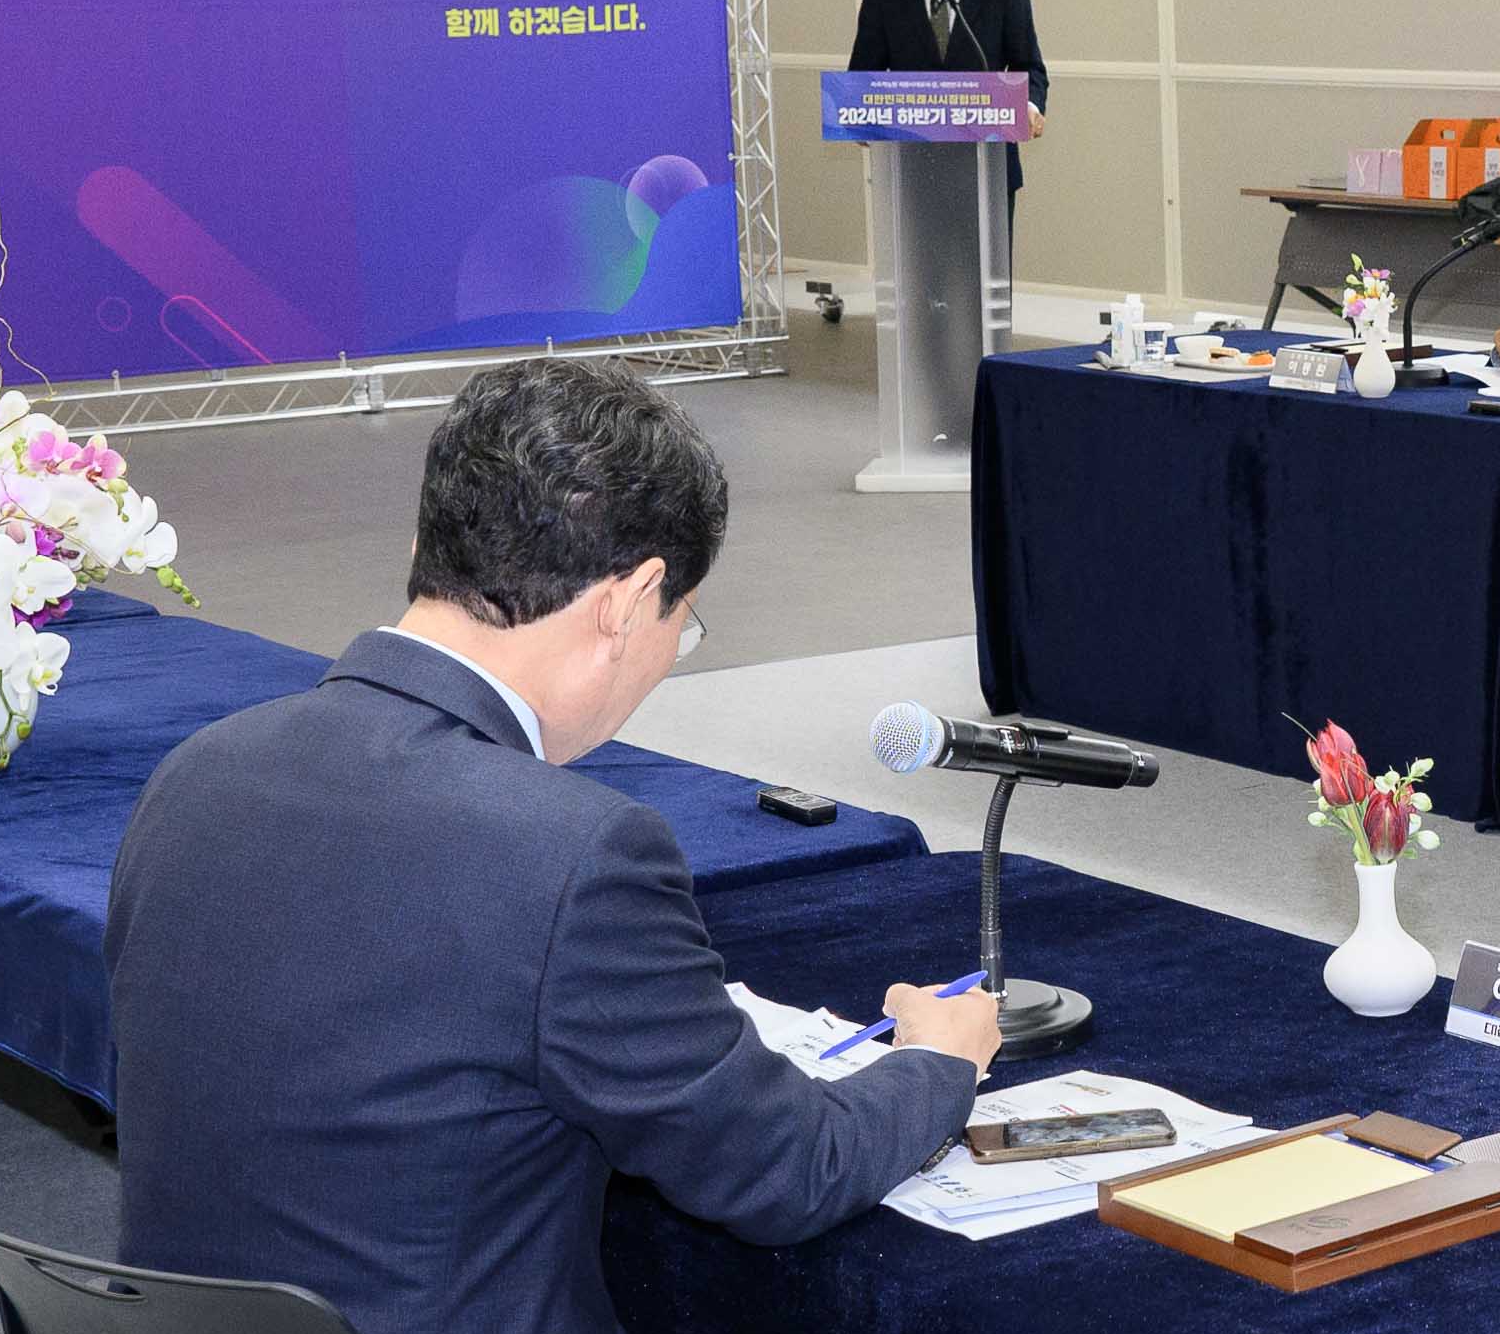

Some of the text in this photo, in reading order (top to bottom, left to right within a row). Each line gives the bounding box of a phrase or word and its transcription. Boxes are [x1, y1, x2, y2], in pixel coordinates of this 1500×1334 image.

[445, 3, 646, 37] 함께 하겠습니다.
[838, 107, 1016, 126] 2024년 하반기 정기회의
